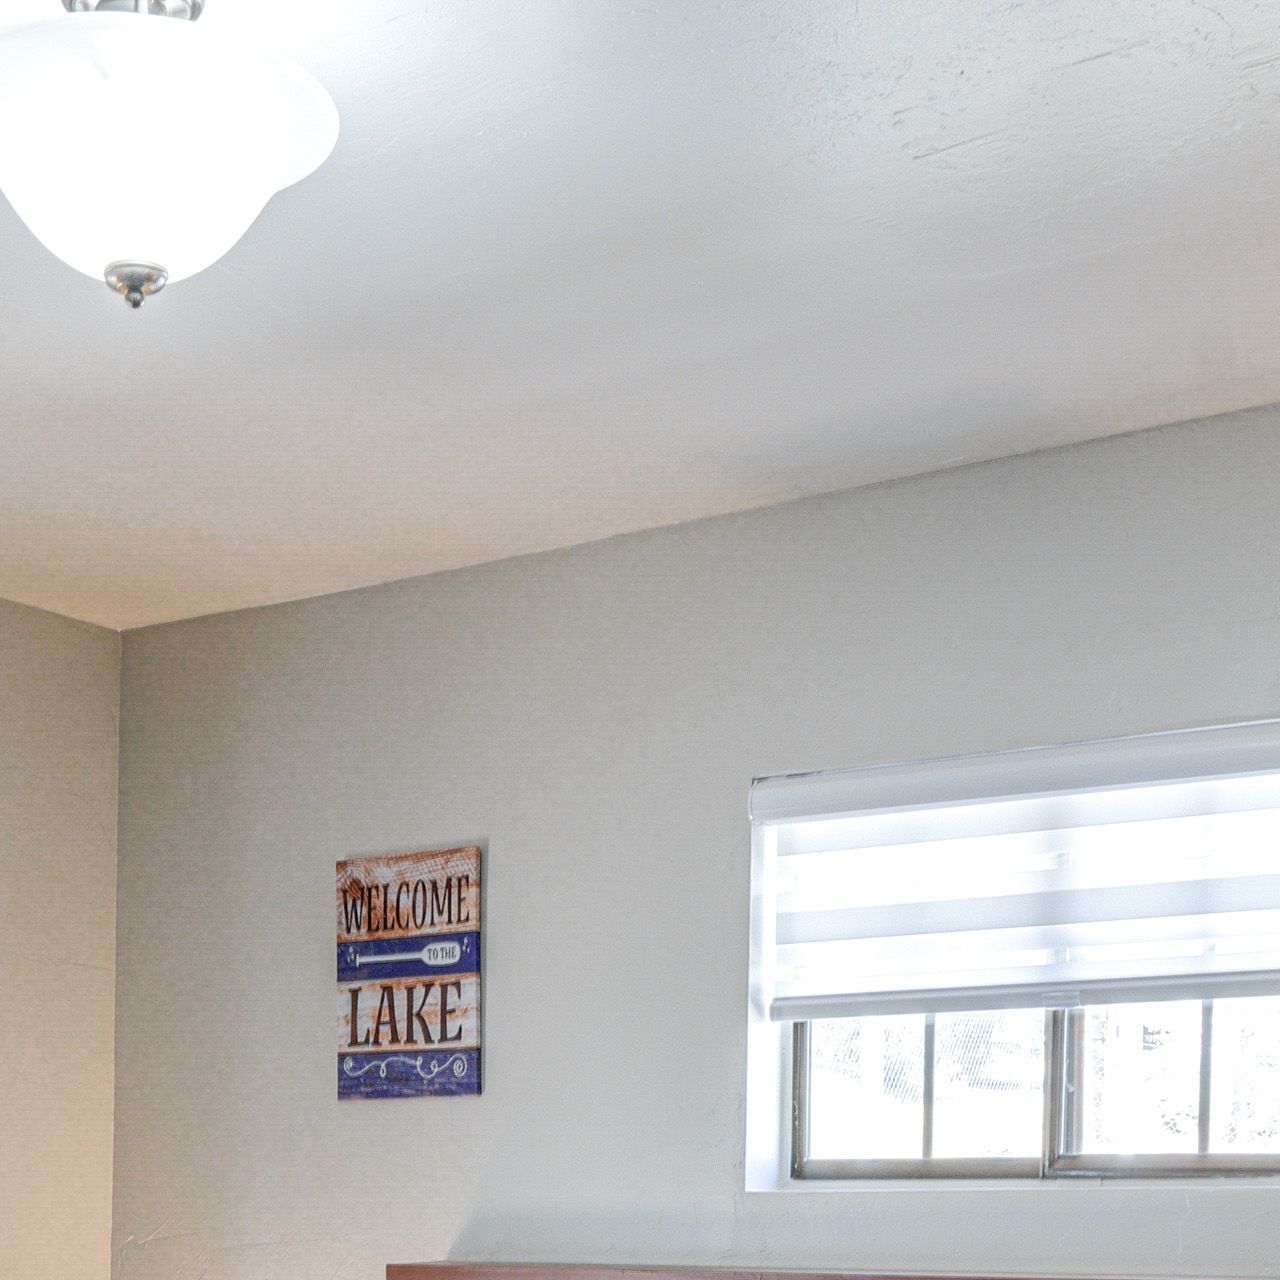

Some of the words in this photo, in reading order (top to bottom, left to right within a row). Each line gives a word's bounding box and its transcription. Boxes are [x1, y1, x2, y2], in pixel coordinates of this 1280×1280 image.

[342, 874, 470, 935] WELCOME
[427, 948, 439, 961] TO
[439, 946, 457, 960] THE
[348, 981, 463, 1047] LAKE
